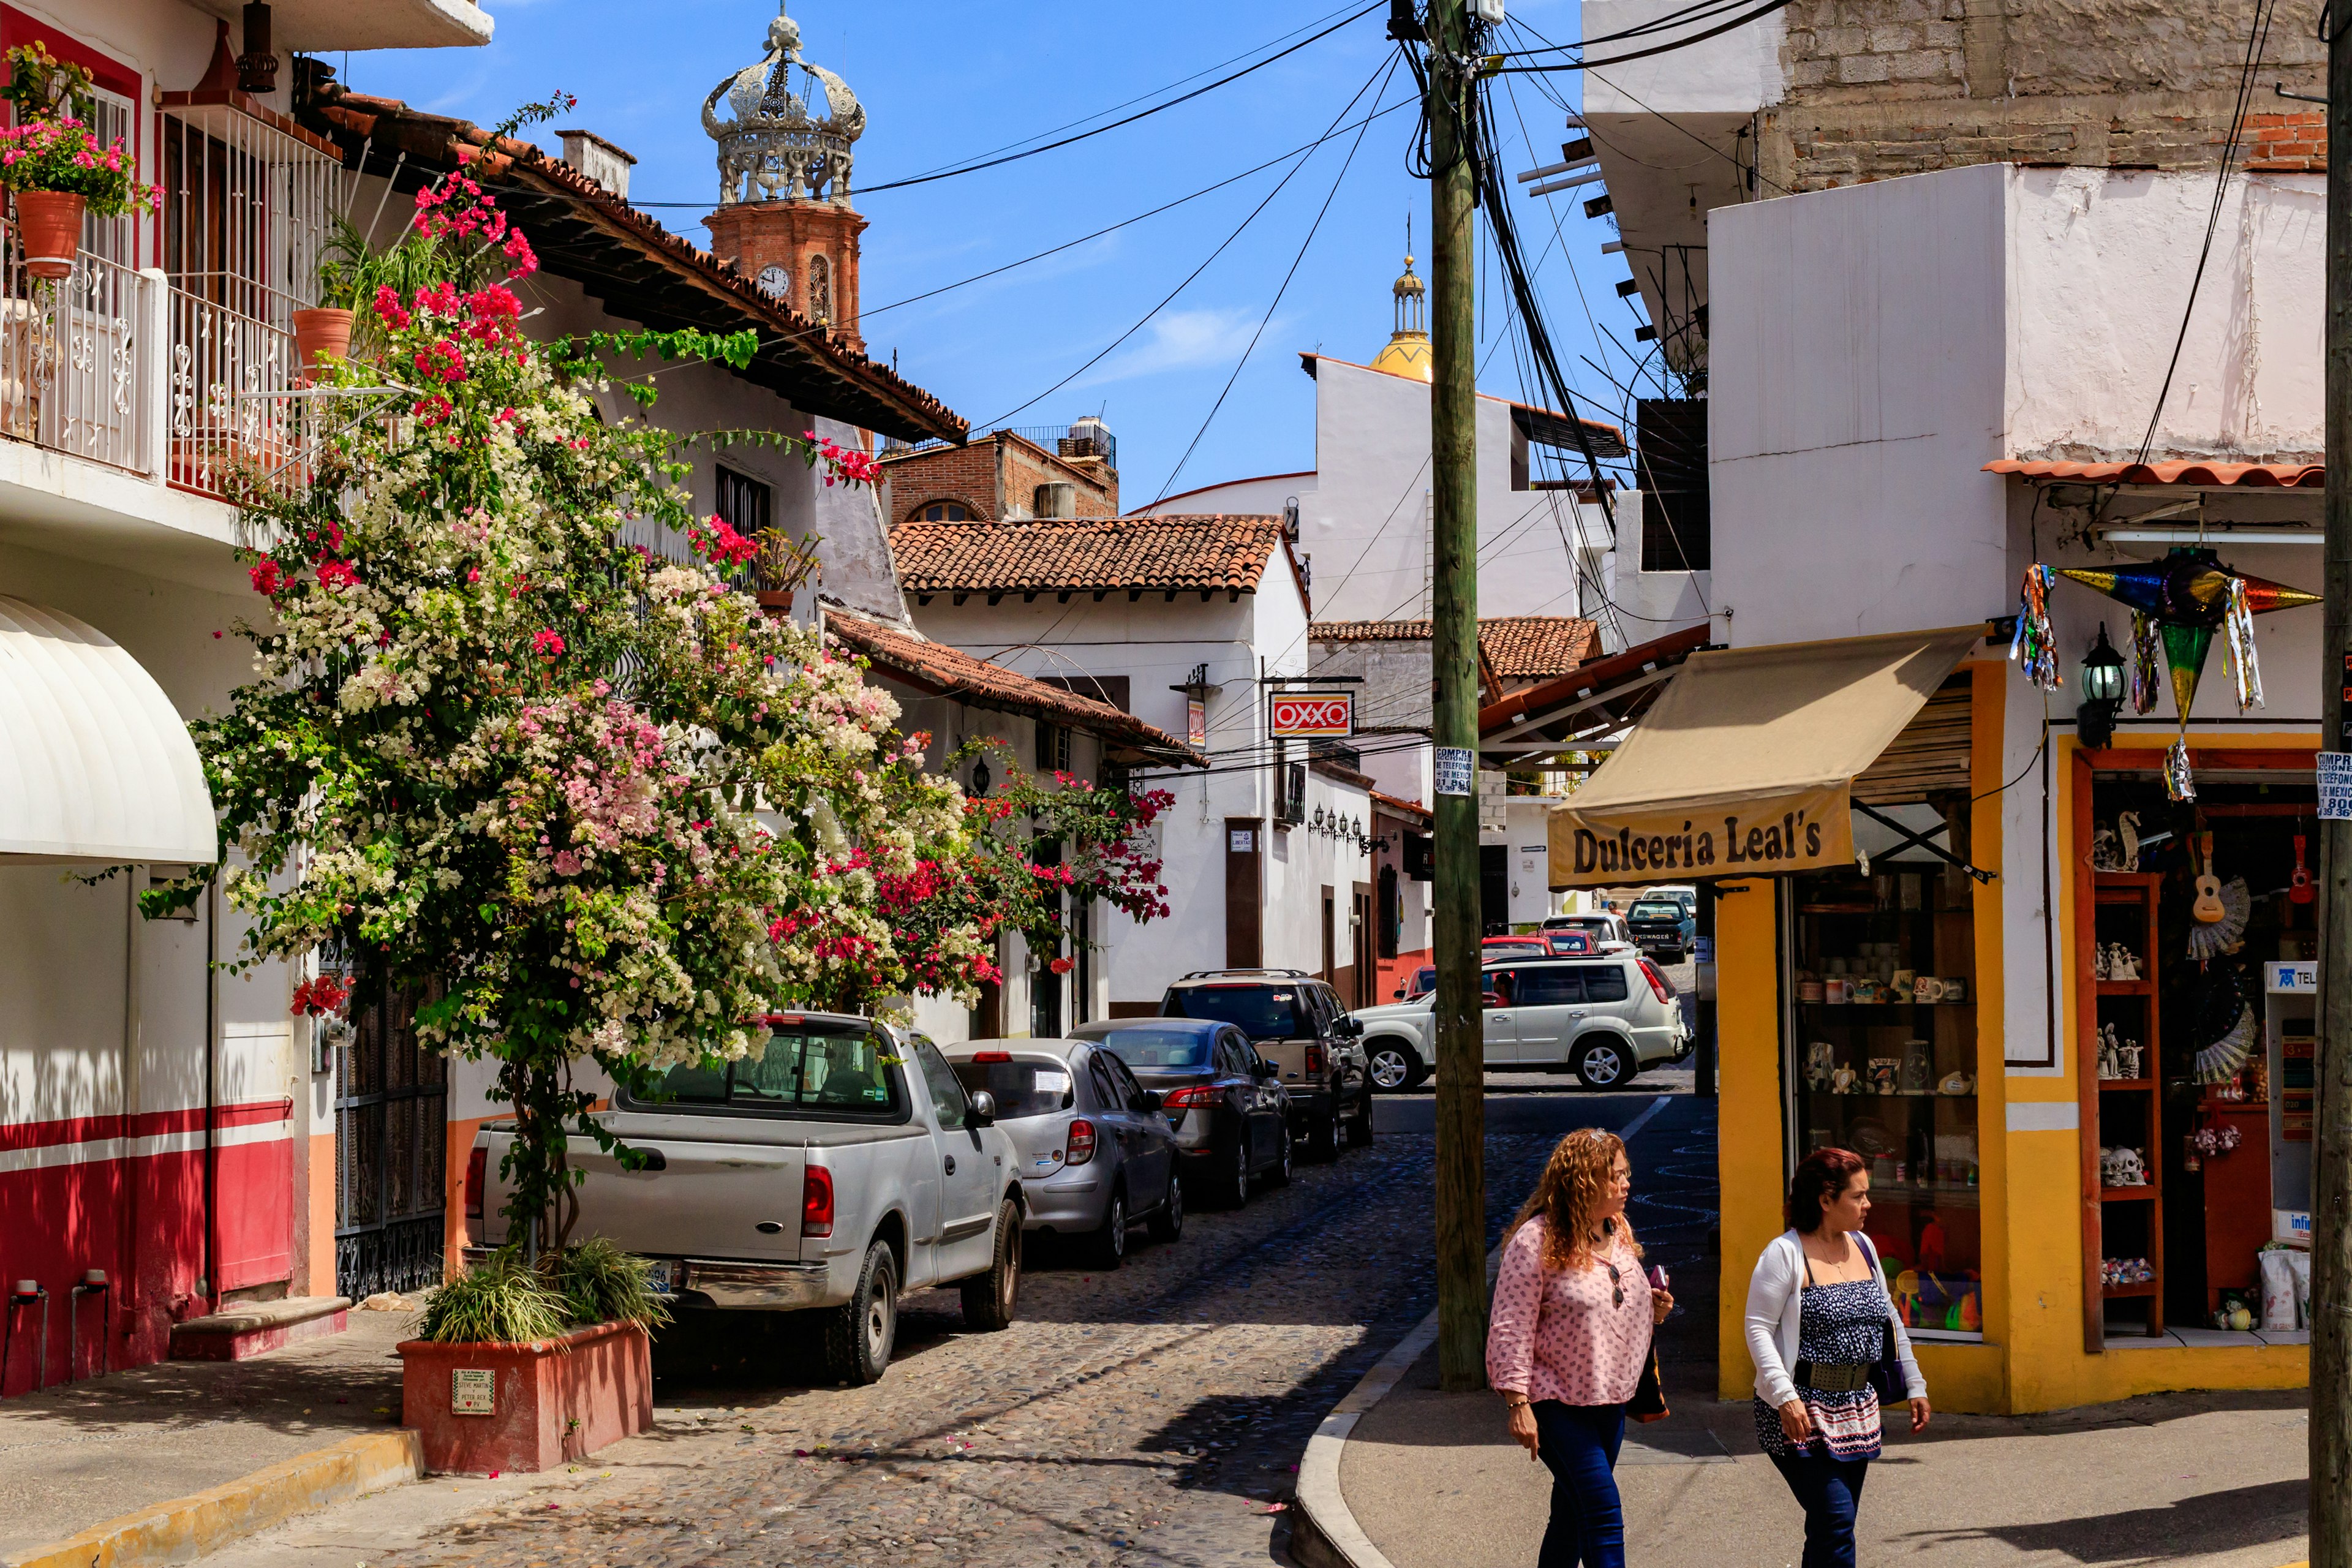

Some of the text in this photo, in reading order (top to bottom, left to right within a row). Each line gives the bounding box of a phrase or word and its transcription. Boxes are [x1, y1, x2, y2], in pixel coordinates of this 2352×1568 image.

[1189, 710, 1204, 736] OXXO
[1276, 702, 1347, 729] OXXO
[1437, 748, 1472, 758] COMPRO
[1452, 779, 1471, 788] 800
[1573, 810, 1820, 874] Dulcería Leal's
[2297, 972, 2317, 984] TEL
